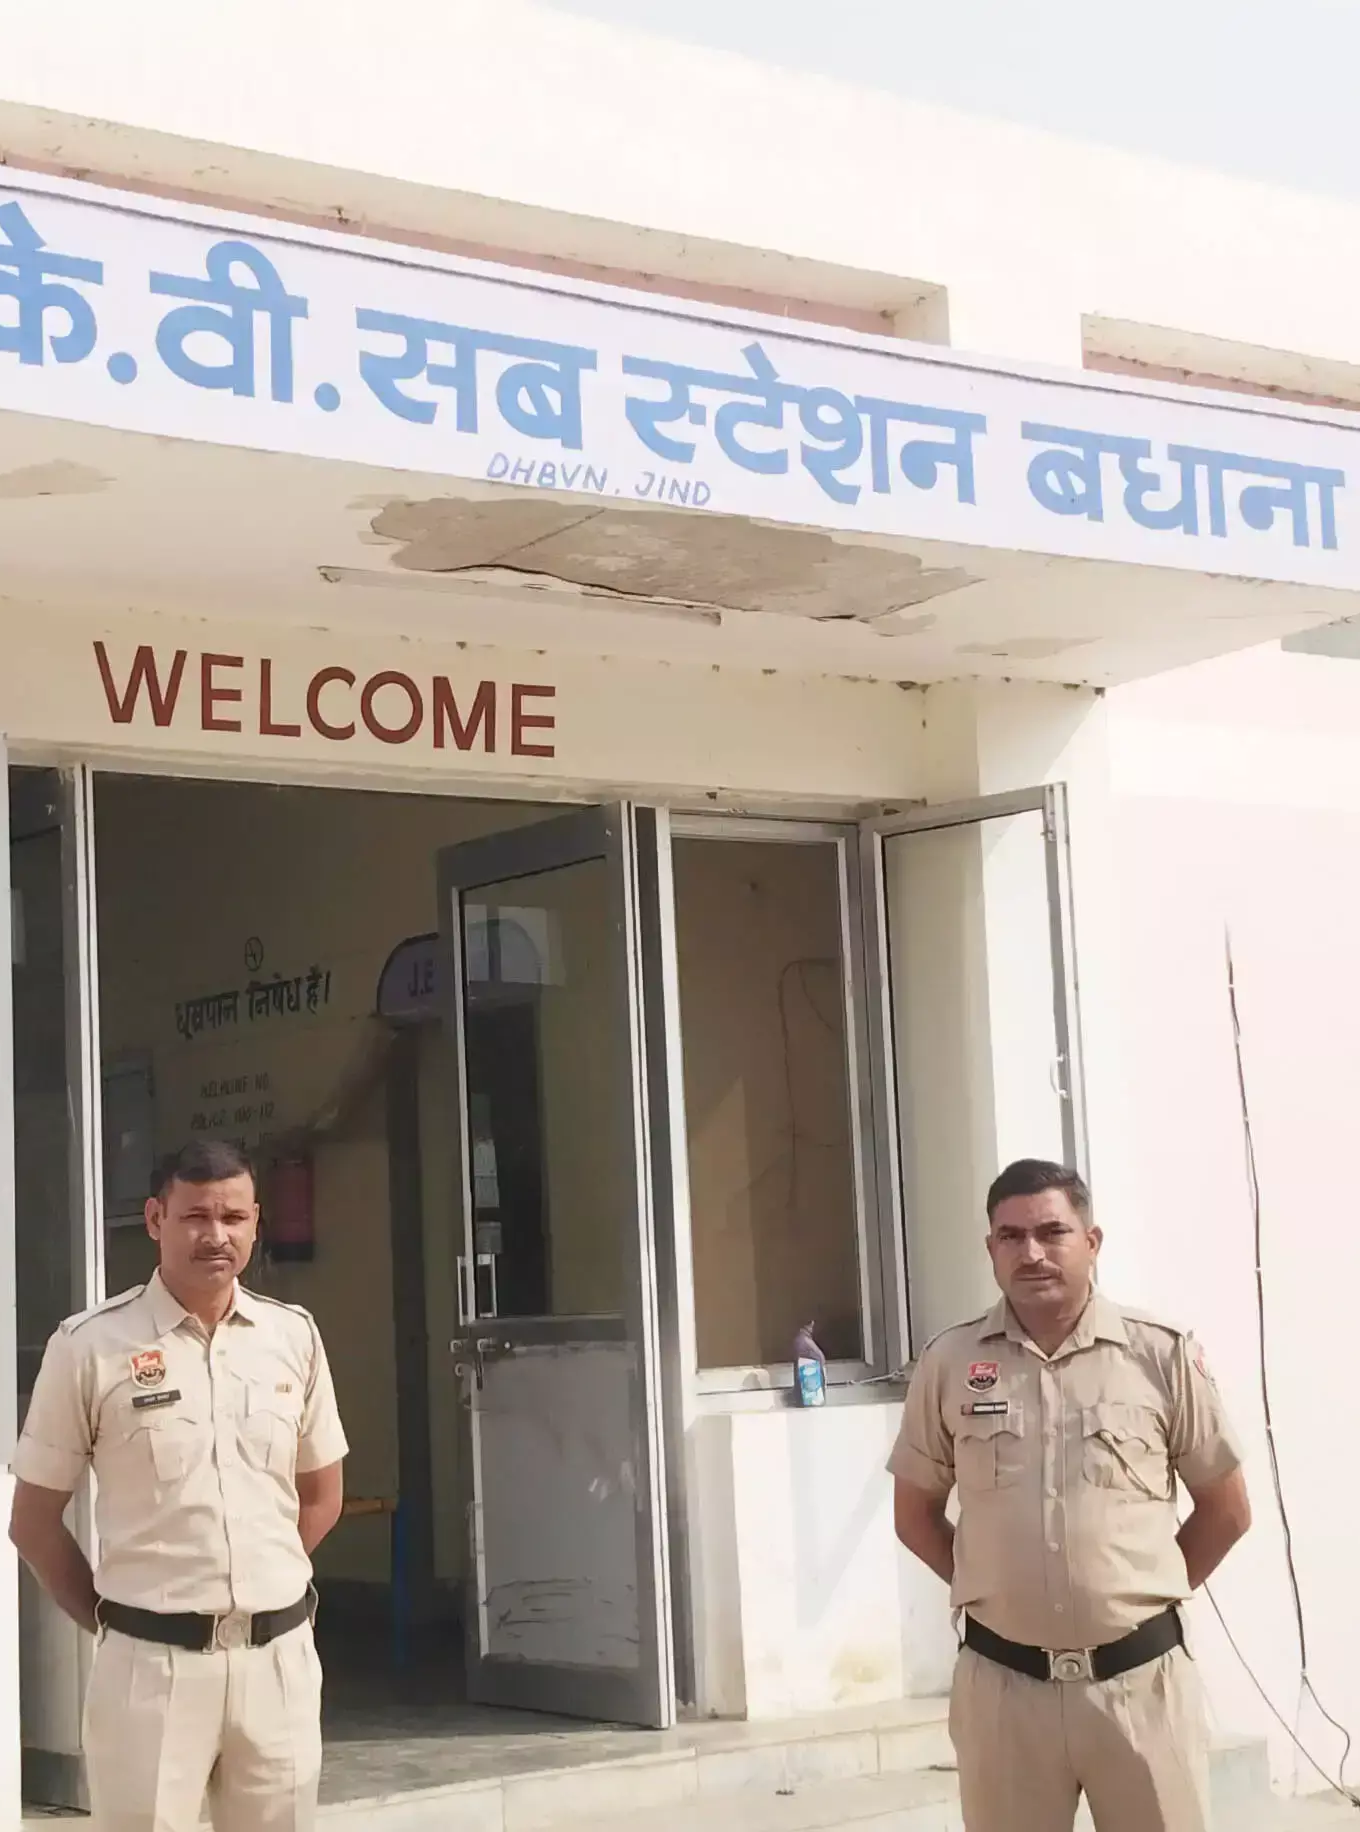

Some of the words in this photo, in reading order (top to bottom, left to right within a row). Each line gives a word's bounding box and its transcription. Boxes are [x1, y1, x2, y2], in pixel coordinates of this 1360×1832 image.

[622, 342, 987, 505] स्टेशन
[1021, 421, 1344, 550] बधाना
[634, 470, 711, 506] JIND
[92, 640, 557, 758] WELCOME
